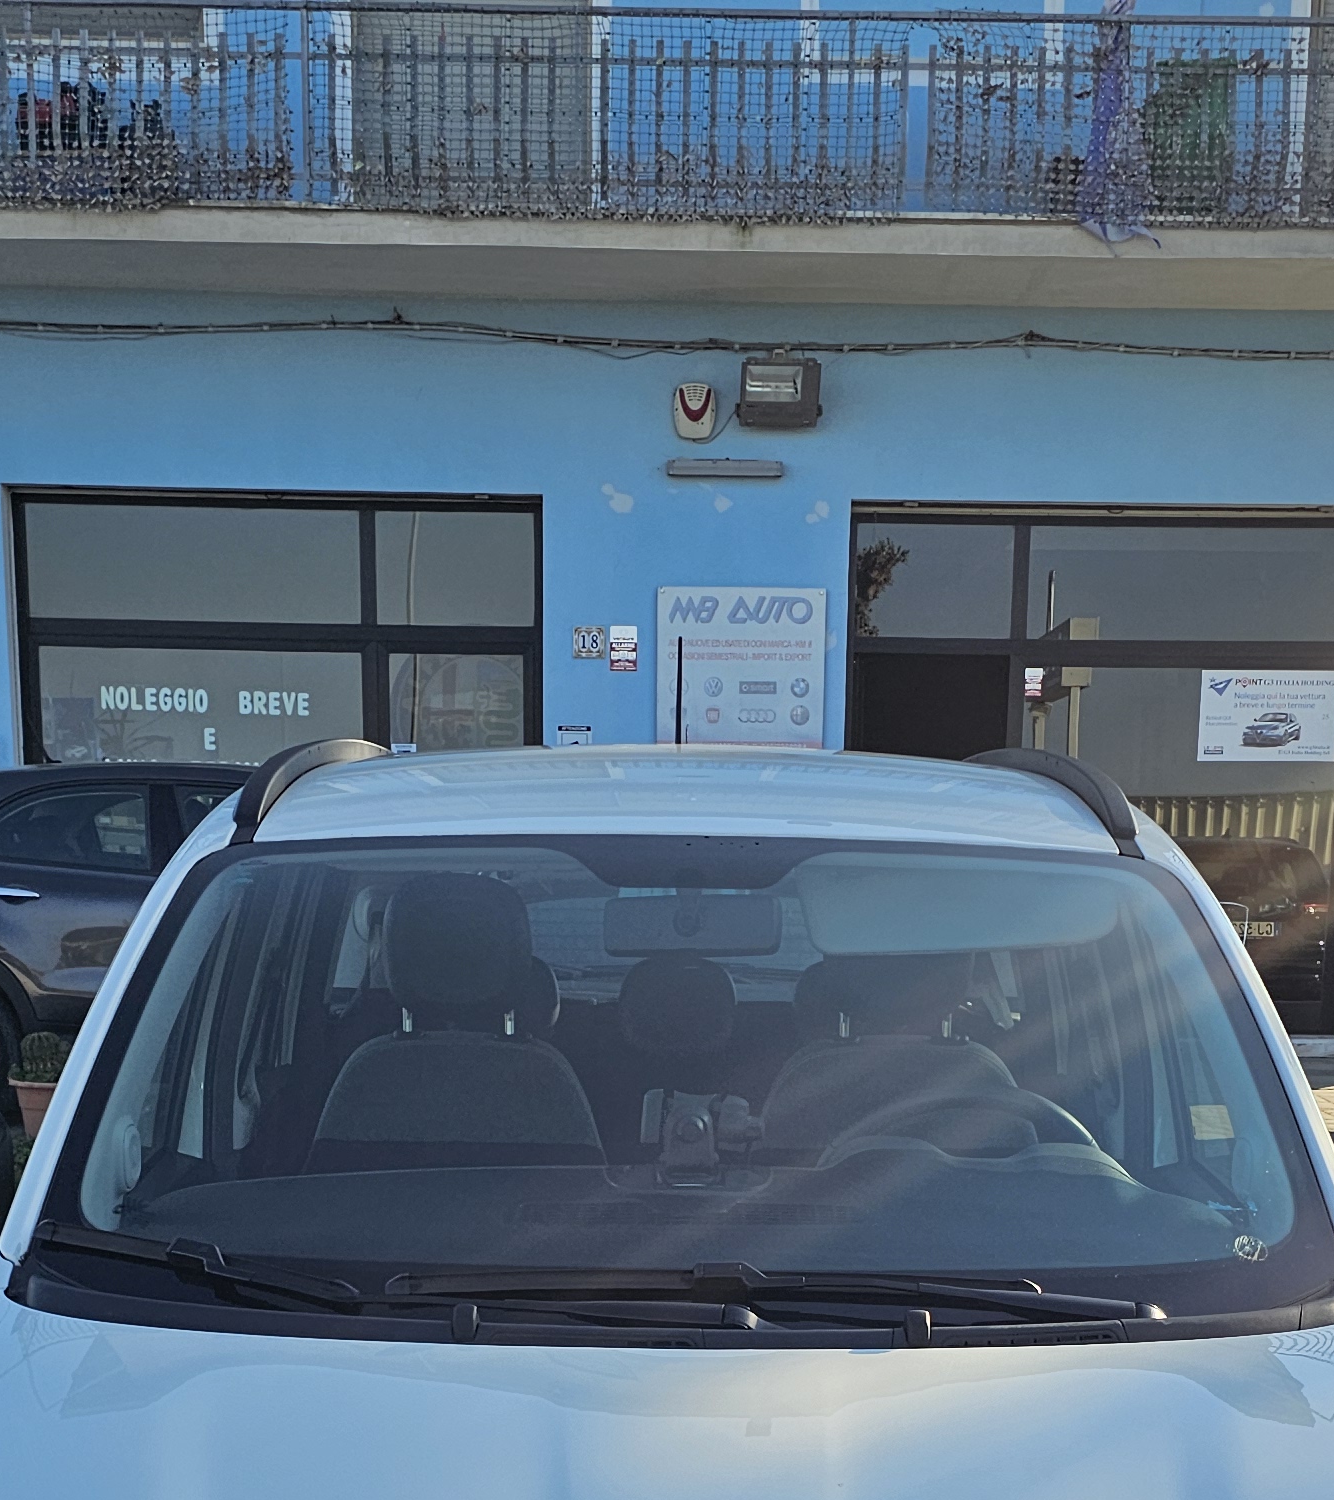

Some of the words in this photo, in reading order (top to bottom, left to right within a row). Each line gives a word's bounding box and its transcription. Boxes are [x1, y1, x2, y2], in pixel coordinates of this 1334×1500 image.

[727, 595, 814, 625] AUTO
[580, 634, 599, 649] 18
[668, 652, 705, 661] OCASIONI
[785, 652, 812, 661] EXPORT
[1301, 679, 1334, 687] HOLDING
[99, 685, 209, 713] NOLEGGIO
[238, 690, 310, 716] BREVE
[1234, 692, 1265, 701] Noleggia
[1267, 692, 1278, 701] qui
[1279, 692, 1285, 700] la
[1286, 692, 1298, 700] tua
[1299, 692, 1326, 700] vettura
[1266, 702, 1286, 711] lungo
[203, 727, 217, 750] E
